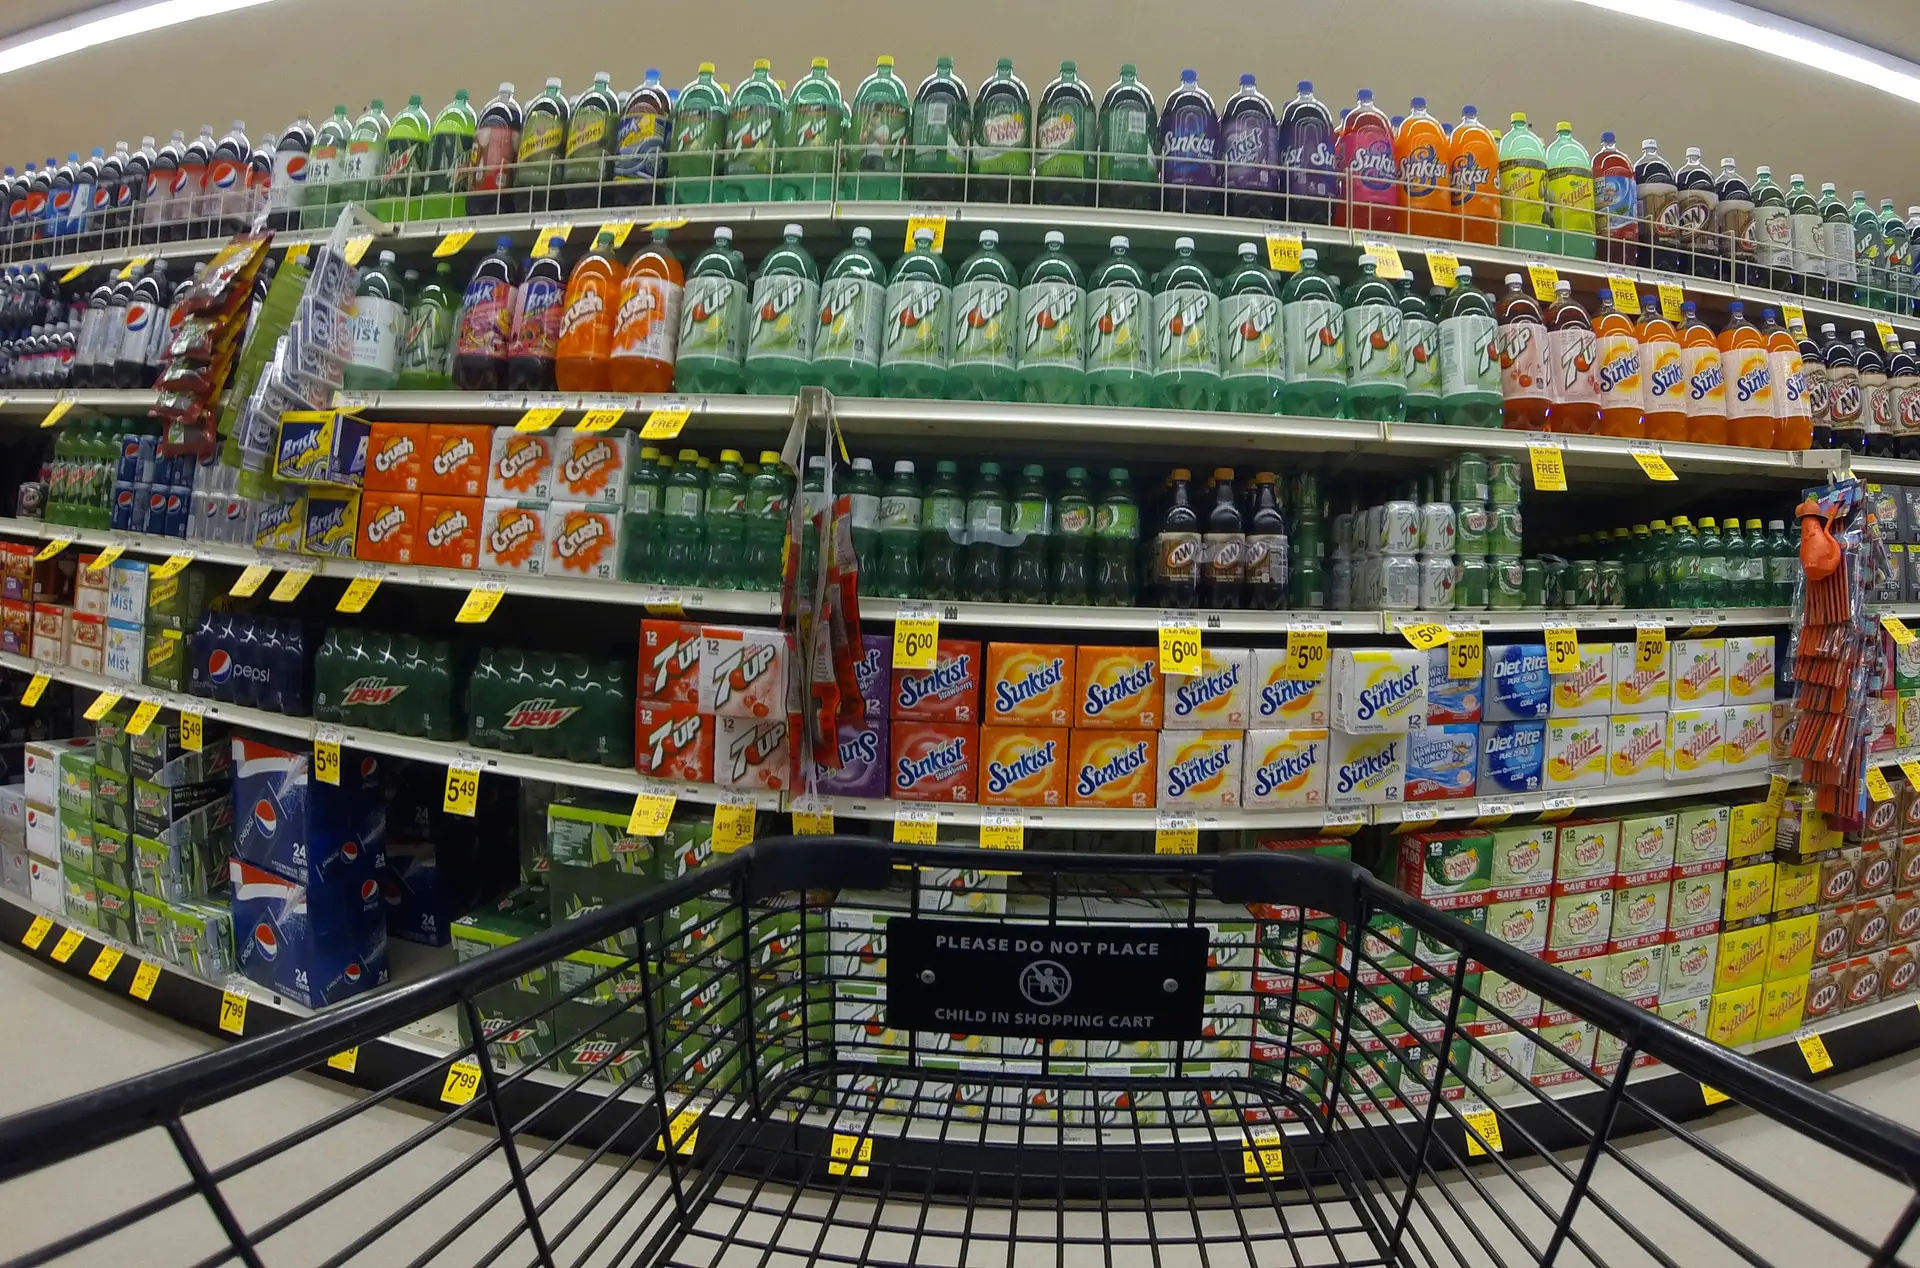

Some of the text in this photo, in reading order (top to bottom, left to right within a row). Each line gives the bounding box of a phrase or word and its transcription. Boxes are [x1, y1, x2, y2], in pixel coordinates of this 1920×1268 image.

[1161, 131, 1216, 156] Sunkist
[1400, 157, 1447, 182] Sunkist
[1615, 292, 1635, 301] FREE
[681, 282, 733, 345] 7UP
[751, 280, 802, 345] 7UP
[887, 288, 941, 350] 7UP
[955, 287, 1008, 351] 7UP
[1025, 288, 1078, 353] 7UP
[1088, 291, 1139, 358] 7UP
[1158, 294, 1208, 359] 7UP
[1228, 299, 1277, 362] 7UP
[1609, 357, 1622, 370] Diet
[1660, 363, 1673, 376] Diet
[282, 428, 319, 458] Brisk
[375, 437, 414, 472] Crush
[433, 438, 474, 475] Crush
[499, 440, 543, 480] Crush
[564, 441, 612, 483] Crush
[1536, 464, 1560, 474] FREE
[1643, 462, 1667, 471] FREE
[535, 484, 548, 495] 12
[604, 487, 617, 497] 12
[367, 506, 406, 544] Crush
[427, 511, 468, 547] Crush
[489, 514, 534, 553] Crush
[556, 515, 604, 558] Crush
[527, 560, 540, 570] 12
[598, 565, 610, 575] 12
[110, 594, 133, 612] Mist
[645, 631, 658, 641] 12
[1179, 628, 1198, 636] Price!
[706, 640, 719, 651] 12
[107, 654, 130, 672] Mist
[233, 663, 271, 682] pepsi
[1493, 656, 1546, 679] Diet Rite
[713, 644, 776, 711] 7UP
[900, 656, 970, 708] Sunkist
[995, 658, 1064, 713] Sunkist
[1189, 675, 1205, 691] Diet
[1372, 679, 1388, 693] Diet
[938, 680, 973, 700] Strawberry
[1084, 661, 1154, 715] Sunkist
[1174, 663, 1240, 716] Sunkist
[1357, 665, 1419, 720] Sunkist
[955, 706, 970, 716] 12
[1386, 688, 1424, 717] Lemonade
[1536, 703, 1548, 713] 12
[640, 710, 652, 720] 12
[723, 719, 735, 729] 12
[1051, 710, 1066, 721] 12
[1139, 712, 1154, 723] 12
[1228, 712, 1242, 722] 12
[1408, 714, 1421, 725] 12
[649, 715, 701, 771] 7UP
[1485, 729, 1540, 754] Diet Rite
[1558, 727, 1600, 770] Squirt
[1619, 722, 1660, 766] Squirt
[1682, 718, 1719, 761] Squirt
[730, 721, 786, 783] 7UP
[1412, 740, 1453, 760] HAWAIIAN
[1418, 751, 1447, 768] PUNCH
[897, 738, 965, 789] Sunkist
[935, 763, 968, 782] Strawberry
[988, 742, 1056, 792] Sunkist
[1077, 743, 1148, 797] Sunkist
[1167, 744, 1232, 797] Sunkist
[1181, 758, 1198, 772] Diet
[1254, 743, 1317, 797] Sunkist
[1268, 758, 1285, 772] Diet
[1337, 742, 1398, 794] Sunkist
[1351, 756, 1366, 771] Diet
[1364, 764, 1400, 789] Lemonade
[1526, 776, 1537, 786] 12
[60, 787, 83, 807] Mist
[952, 786, 967, 796] 12
[1044, 791, 1058, 800] 12
[1132, 792, 1146, 802] 12
[1221, 793, 1235, 802] 12
[1306, 791, 1320, 801] 12
[1385, 786, 1398, 797] 12
[1541, 831, 1553, 840] 12
[62, 842, 85, 862] Mist
[292, 843, 306, 858] 24
[1429, 842, 1443, 852] 12
[1508, 847, 1540, 864] CANADA
[1445, 856, 1480, 873] CANADA
[1454, 865, 1471, 878] DRY
[1517, 858, 1534, 868] DRY
[1682, 862, 1722, 876] SAVE $1.00
[1563, 878, 1609, 890] SAVE $1.00
[1625, 870, 1668, 884] SAVE $1.00
[1430, 895, 1482, 908] SAVE $1.00
[1496, 886, 1546, 900] SAVE $1.00
[66, 896, 90, 915] Mist
[936, 934, 1160, 956] PLEASE DO NOT PLACE
[295, 968, 307, 983] 24
[934, 1008, 1154, 1028] CHILD IN SHOPPING CART
